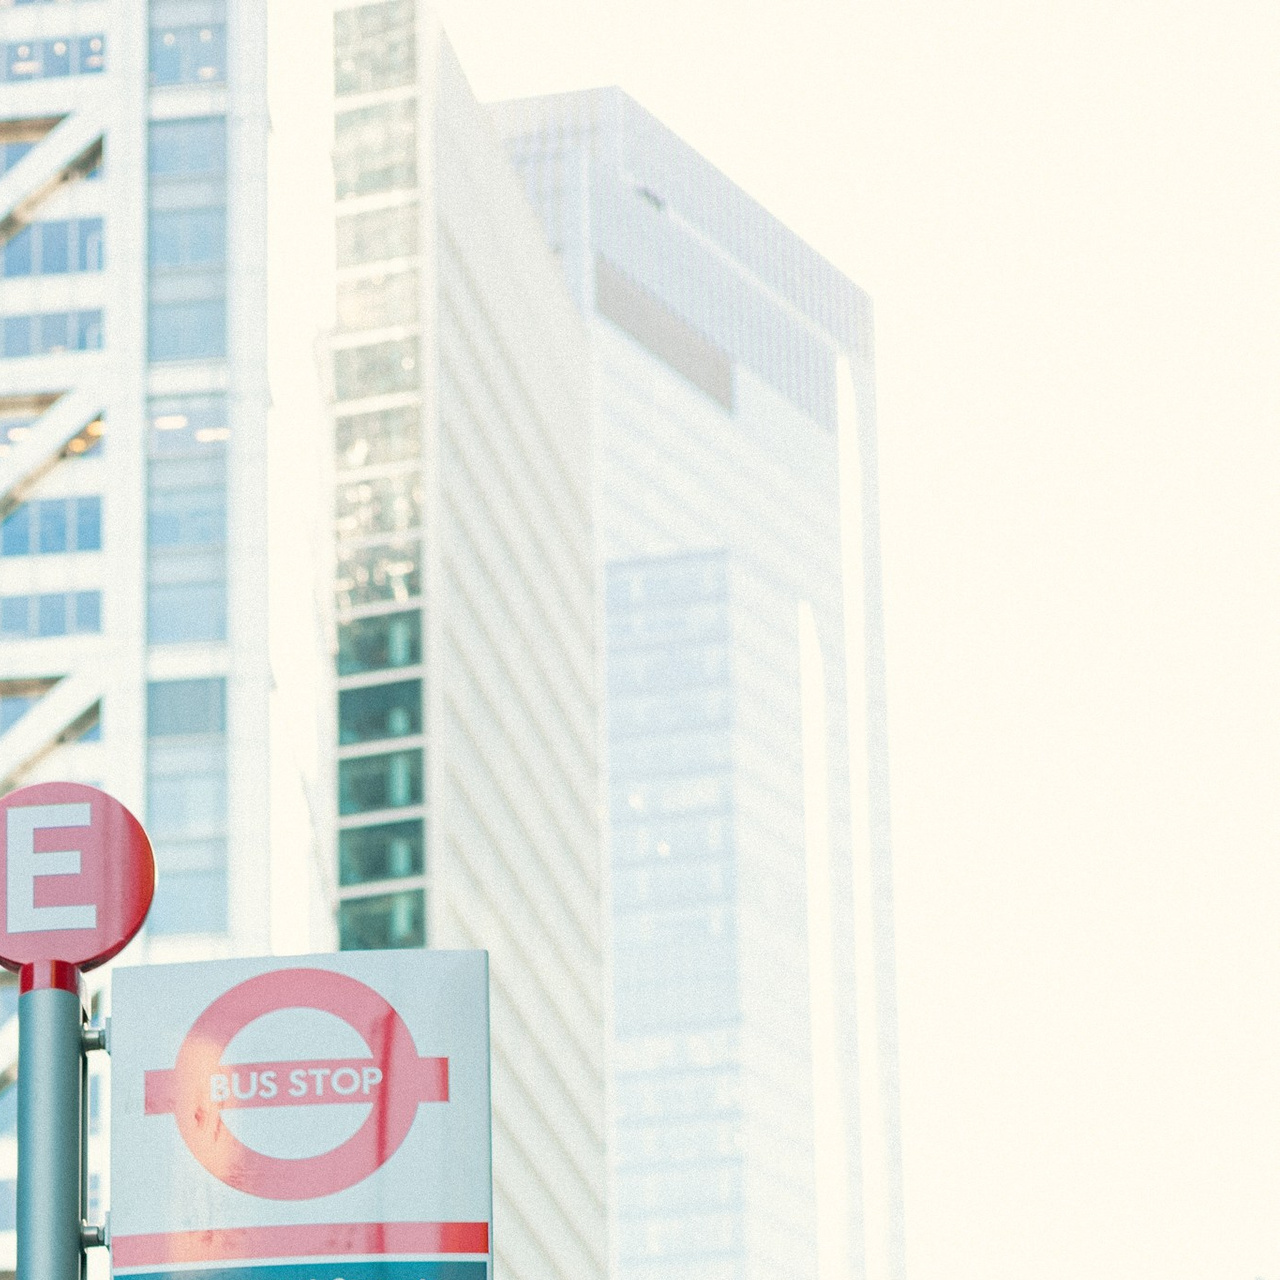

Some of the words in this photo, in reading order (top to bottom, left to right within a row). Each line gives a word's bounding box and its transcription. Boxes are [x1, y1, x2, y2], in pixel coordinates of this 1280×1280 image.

[5, 802, 97, 935] E
[210, 1071, 278, 1101] BUS
[288, 1066, 383, 1097] STOP
